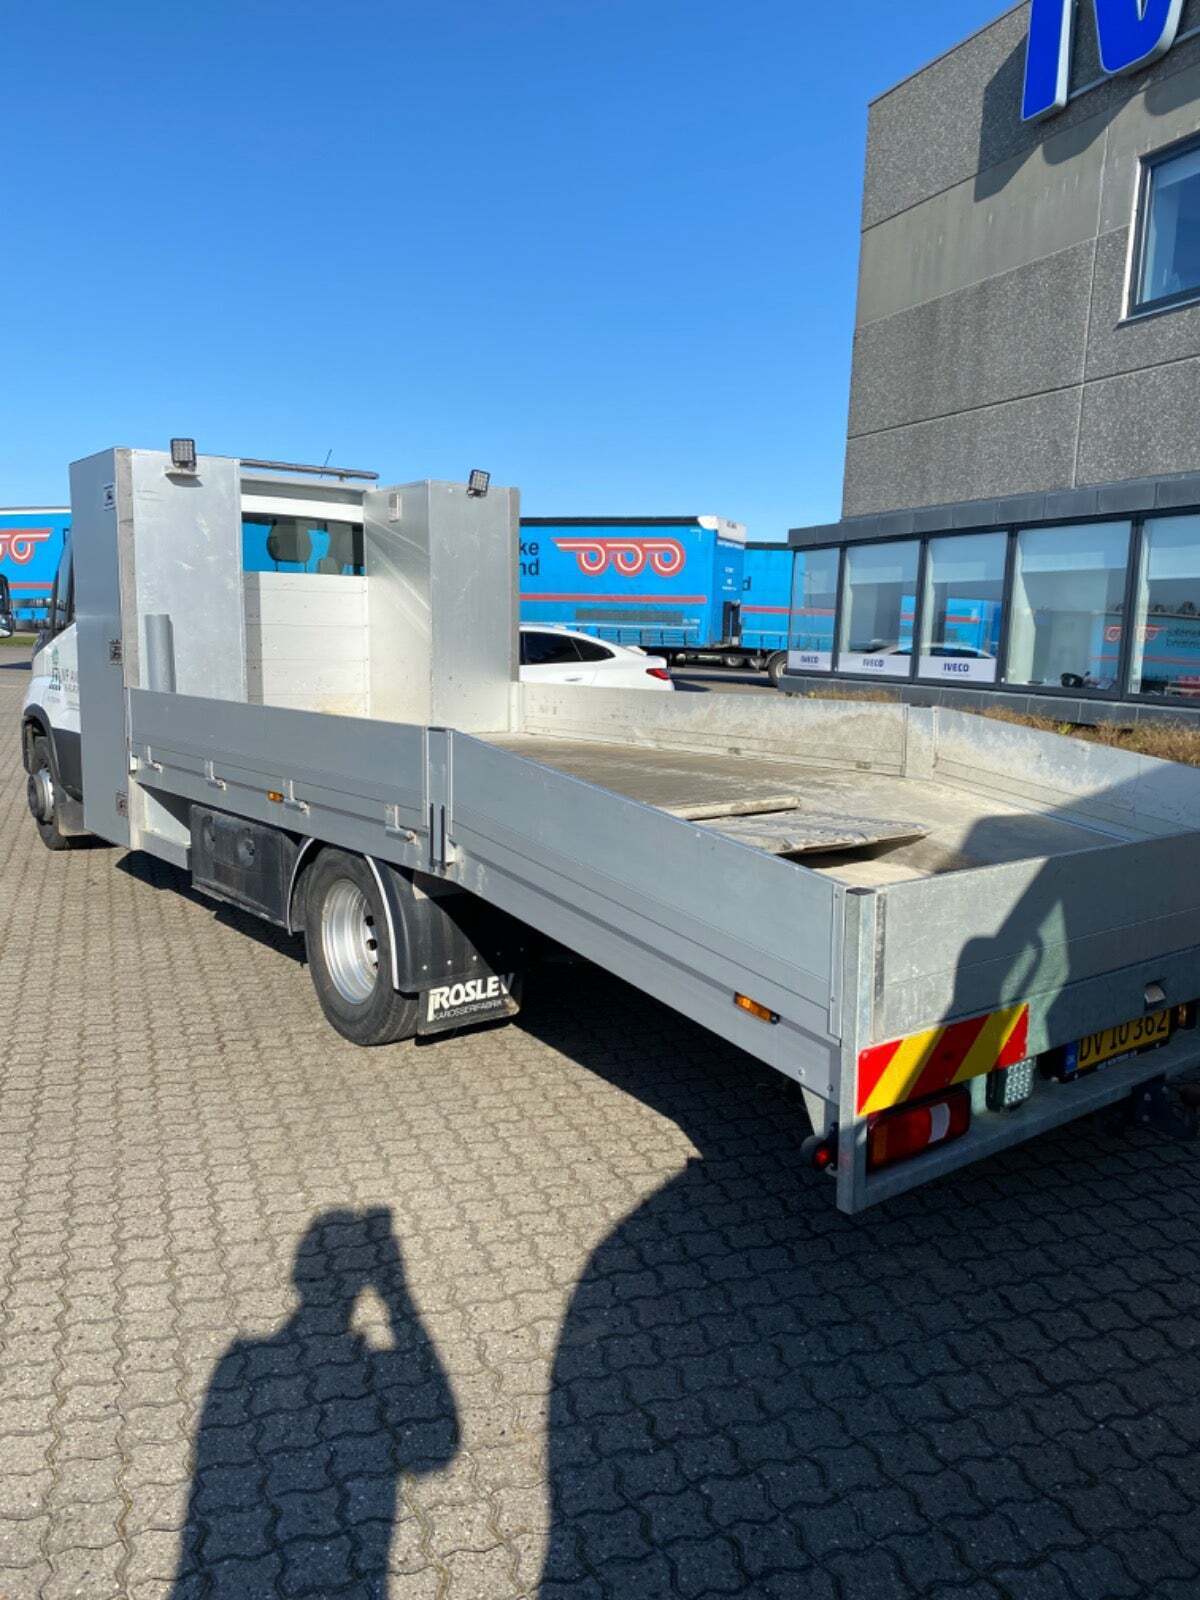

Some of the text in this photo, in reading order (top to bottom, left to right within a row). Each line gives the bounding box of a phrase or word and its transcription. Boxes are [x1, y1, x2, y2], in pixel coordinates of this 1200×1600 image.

[863, 658, 884, 668] IVECO
[943, 662, 969, 672] IVECO
[427, 973, 515, 1022] ROSLEV
[1080, 1031, 1104, 1061] DV
